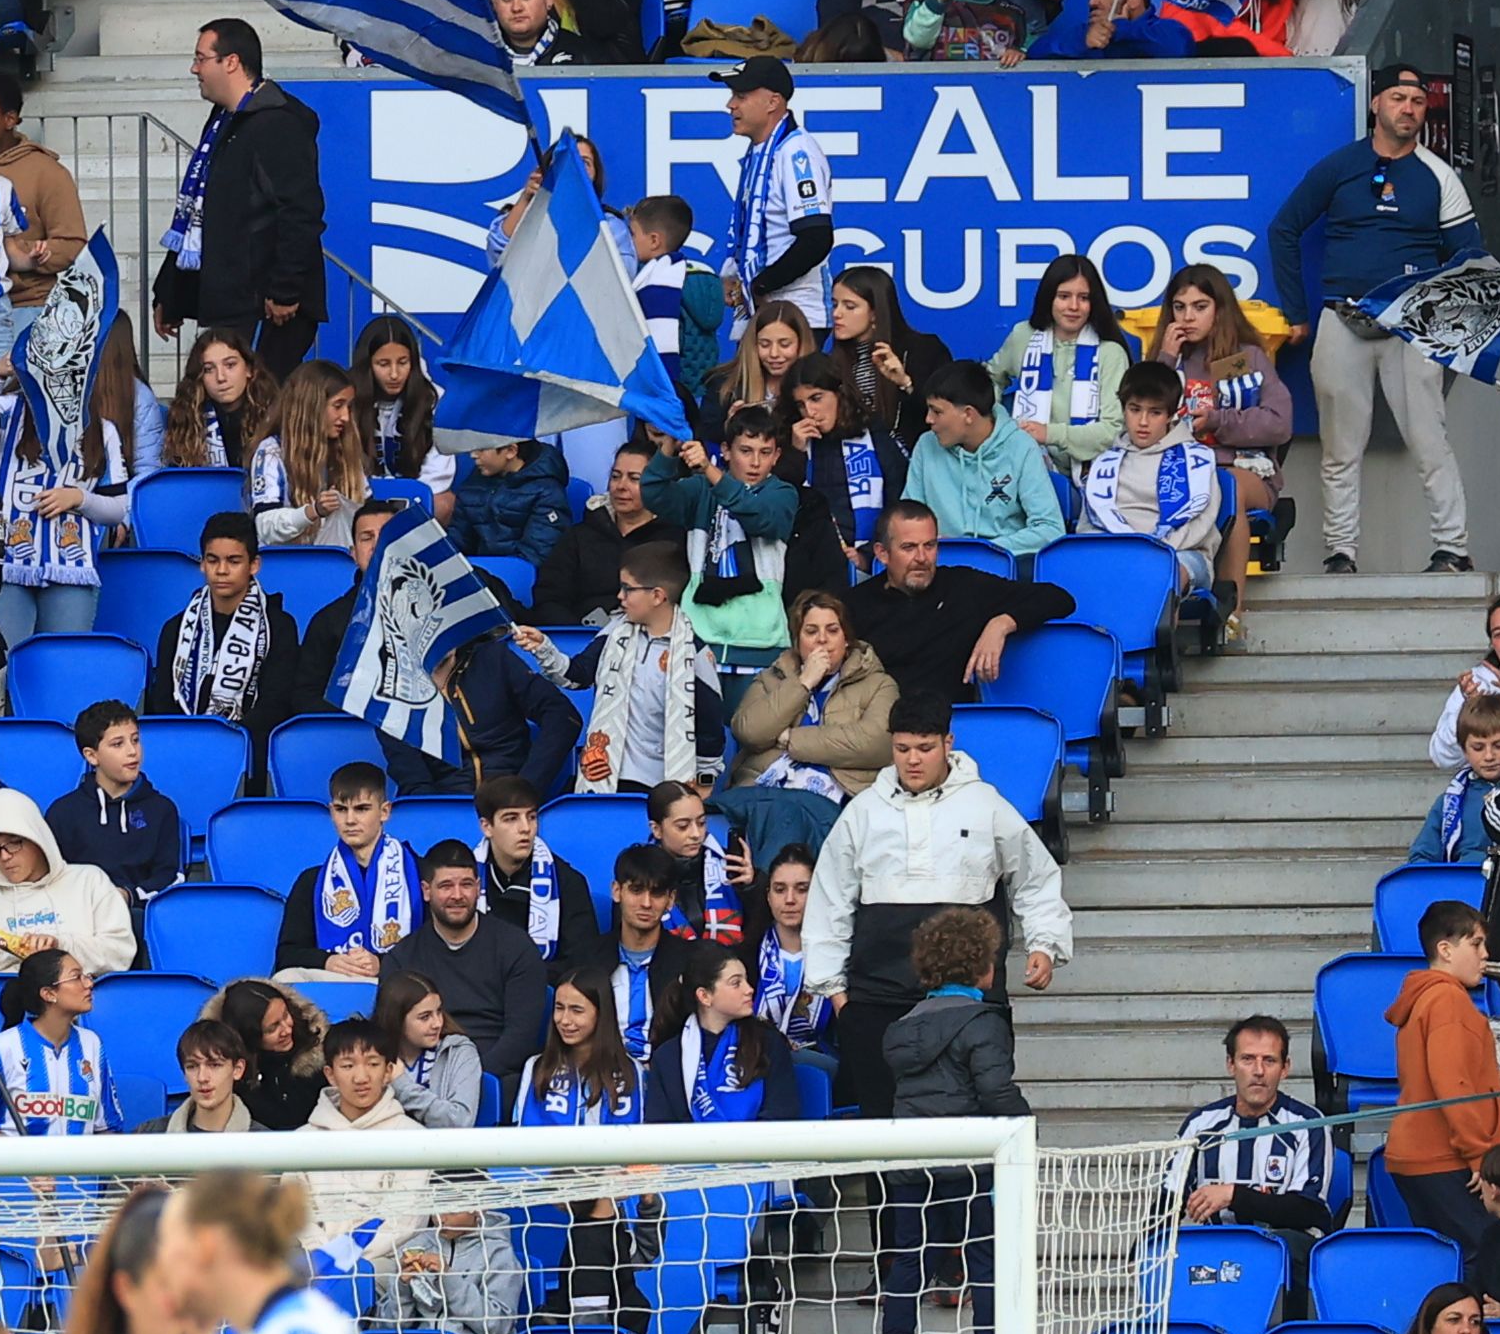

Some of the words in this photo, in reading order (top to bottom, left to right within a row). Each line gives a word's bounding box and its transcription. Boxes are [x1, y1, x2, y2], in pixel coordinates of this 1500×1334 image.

[645, 82, 1250, 202] REALE
[677, 223, 1260, 312] SGUROS
[602, 633, 629, 698] REA
[13, 1093, 97, 1121] GoodBall
